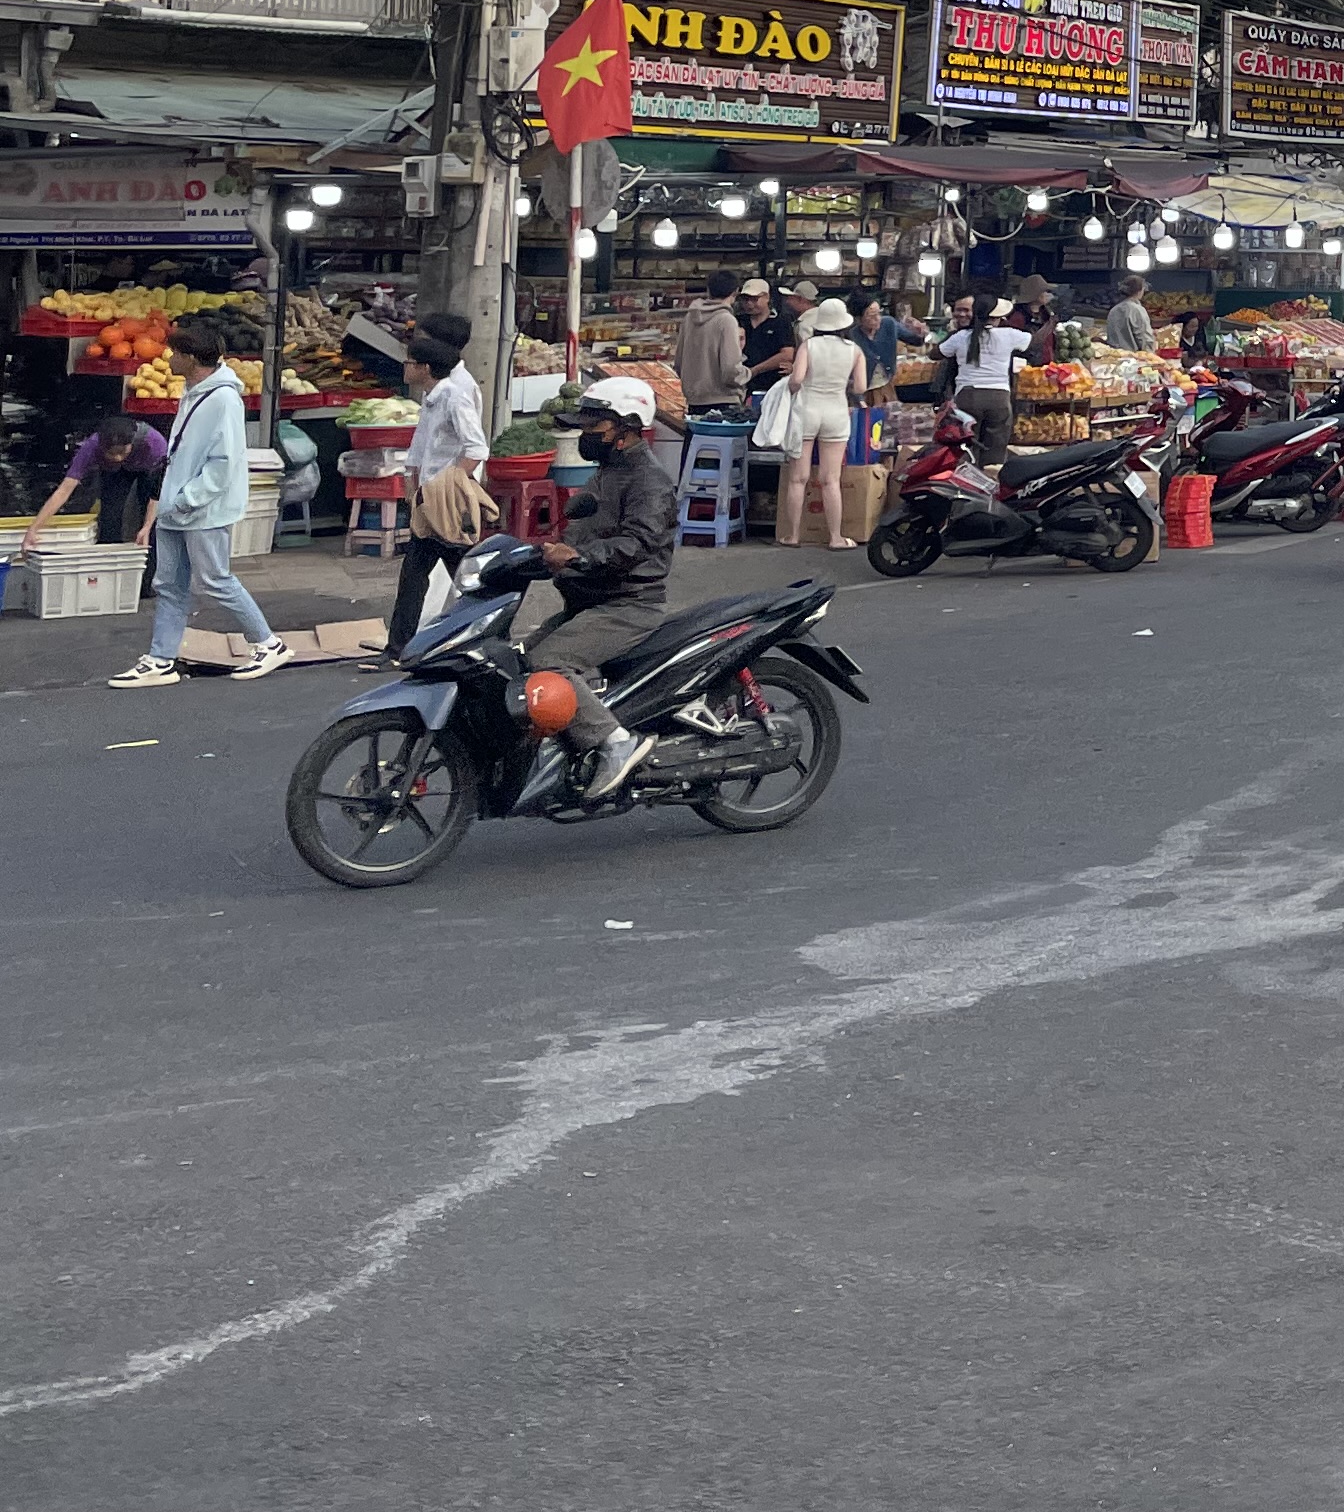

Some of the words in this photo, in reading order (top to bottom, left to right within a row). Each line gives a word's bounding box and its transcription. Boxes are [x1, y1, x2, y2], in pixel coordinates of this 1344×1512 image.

[1080, 0, 1106, 20] TREO
[717, 10, 832, 62] ĐÀO
[953, 7, 1019, 54] THU
[1023, 16, 1125, 65] HƯƠNG
[1291, 31, 1319, 48] ĐẶC
[655, 57, 680, 83] SẢN
[681, 58, 698, 85] ĐÀ
[700, 67, 722, 90] LẠT
[722, 68, 739, 88] UY
[1239, 43, 1289, 78] CẨM
